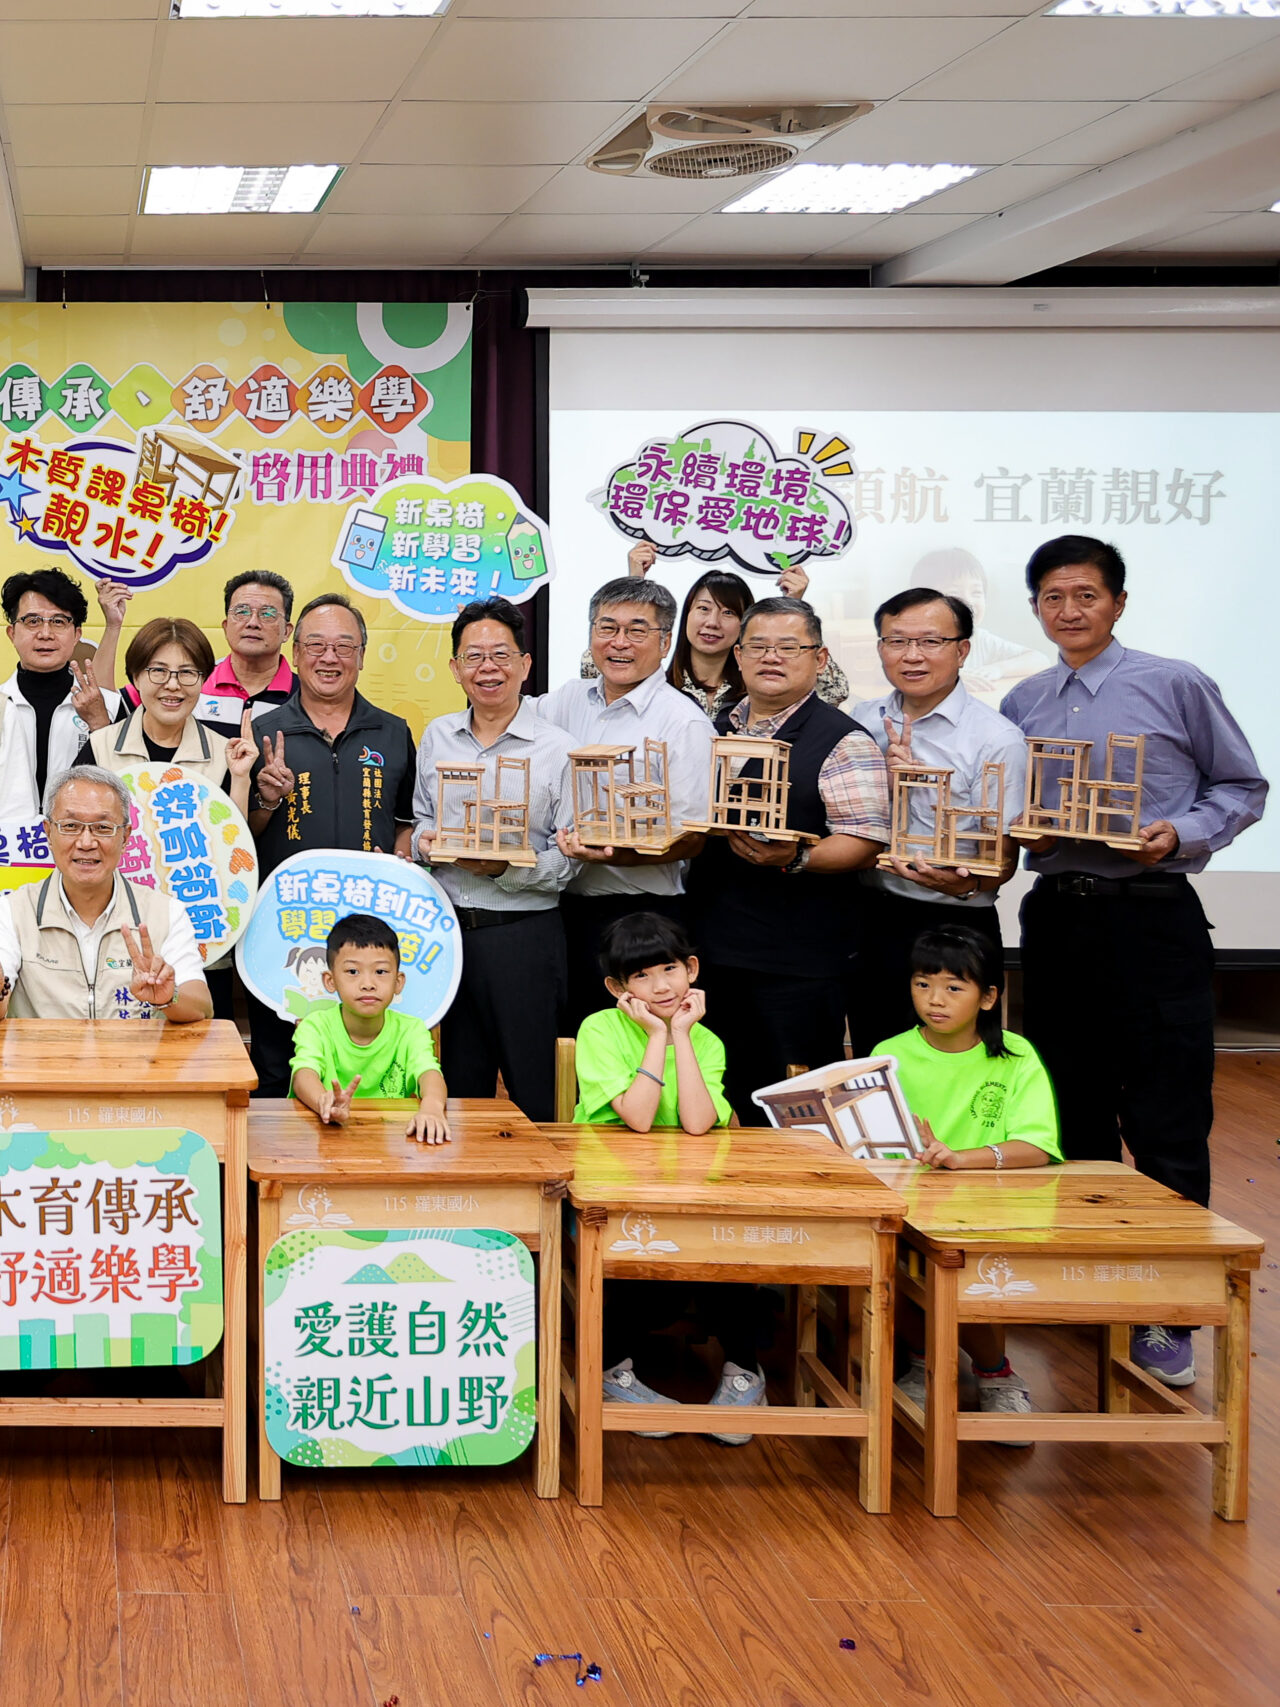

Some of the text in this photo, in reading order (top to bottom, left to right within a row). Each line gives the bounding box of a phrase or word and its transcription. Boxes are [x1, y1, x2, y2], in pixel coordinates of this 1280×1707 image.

[636, 446, 812, 506] 永續環境
[973, 466, 1228, 526] 宜蘭靚好
[42, 494, 164, 570] 靚水！
[610, 483, 847, 550] 環保愛地球！
[298, 771, 312, 814] 理事長
[67, 1106, 163, 1124] 115 羅東國小
[383, 1194, 480, 1213] 115 羅東國小
[711, 1225, 810, 1245] 115 羅東國小
[1060, 1263, 1160, 1283] 115 羅東國小
[294, 1300, 509, 1358] 愛護自然
[291, 1373, 509, 1431] 親近山野
